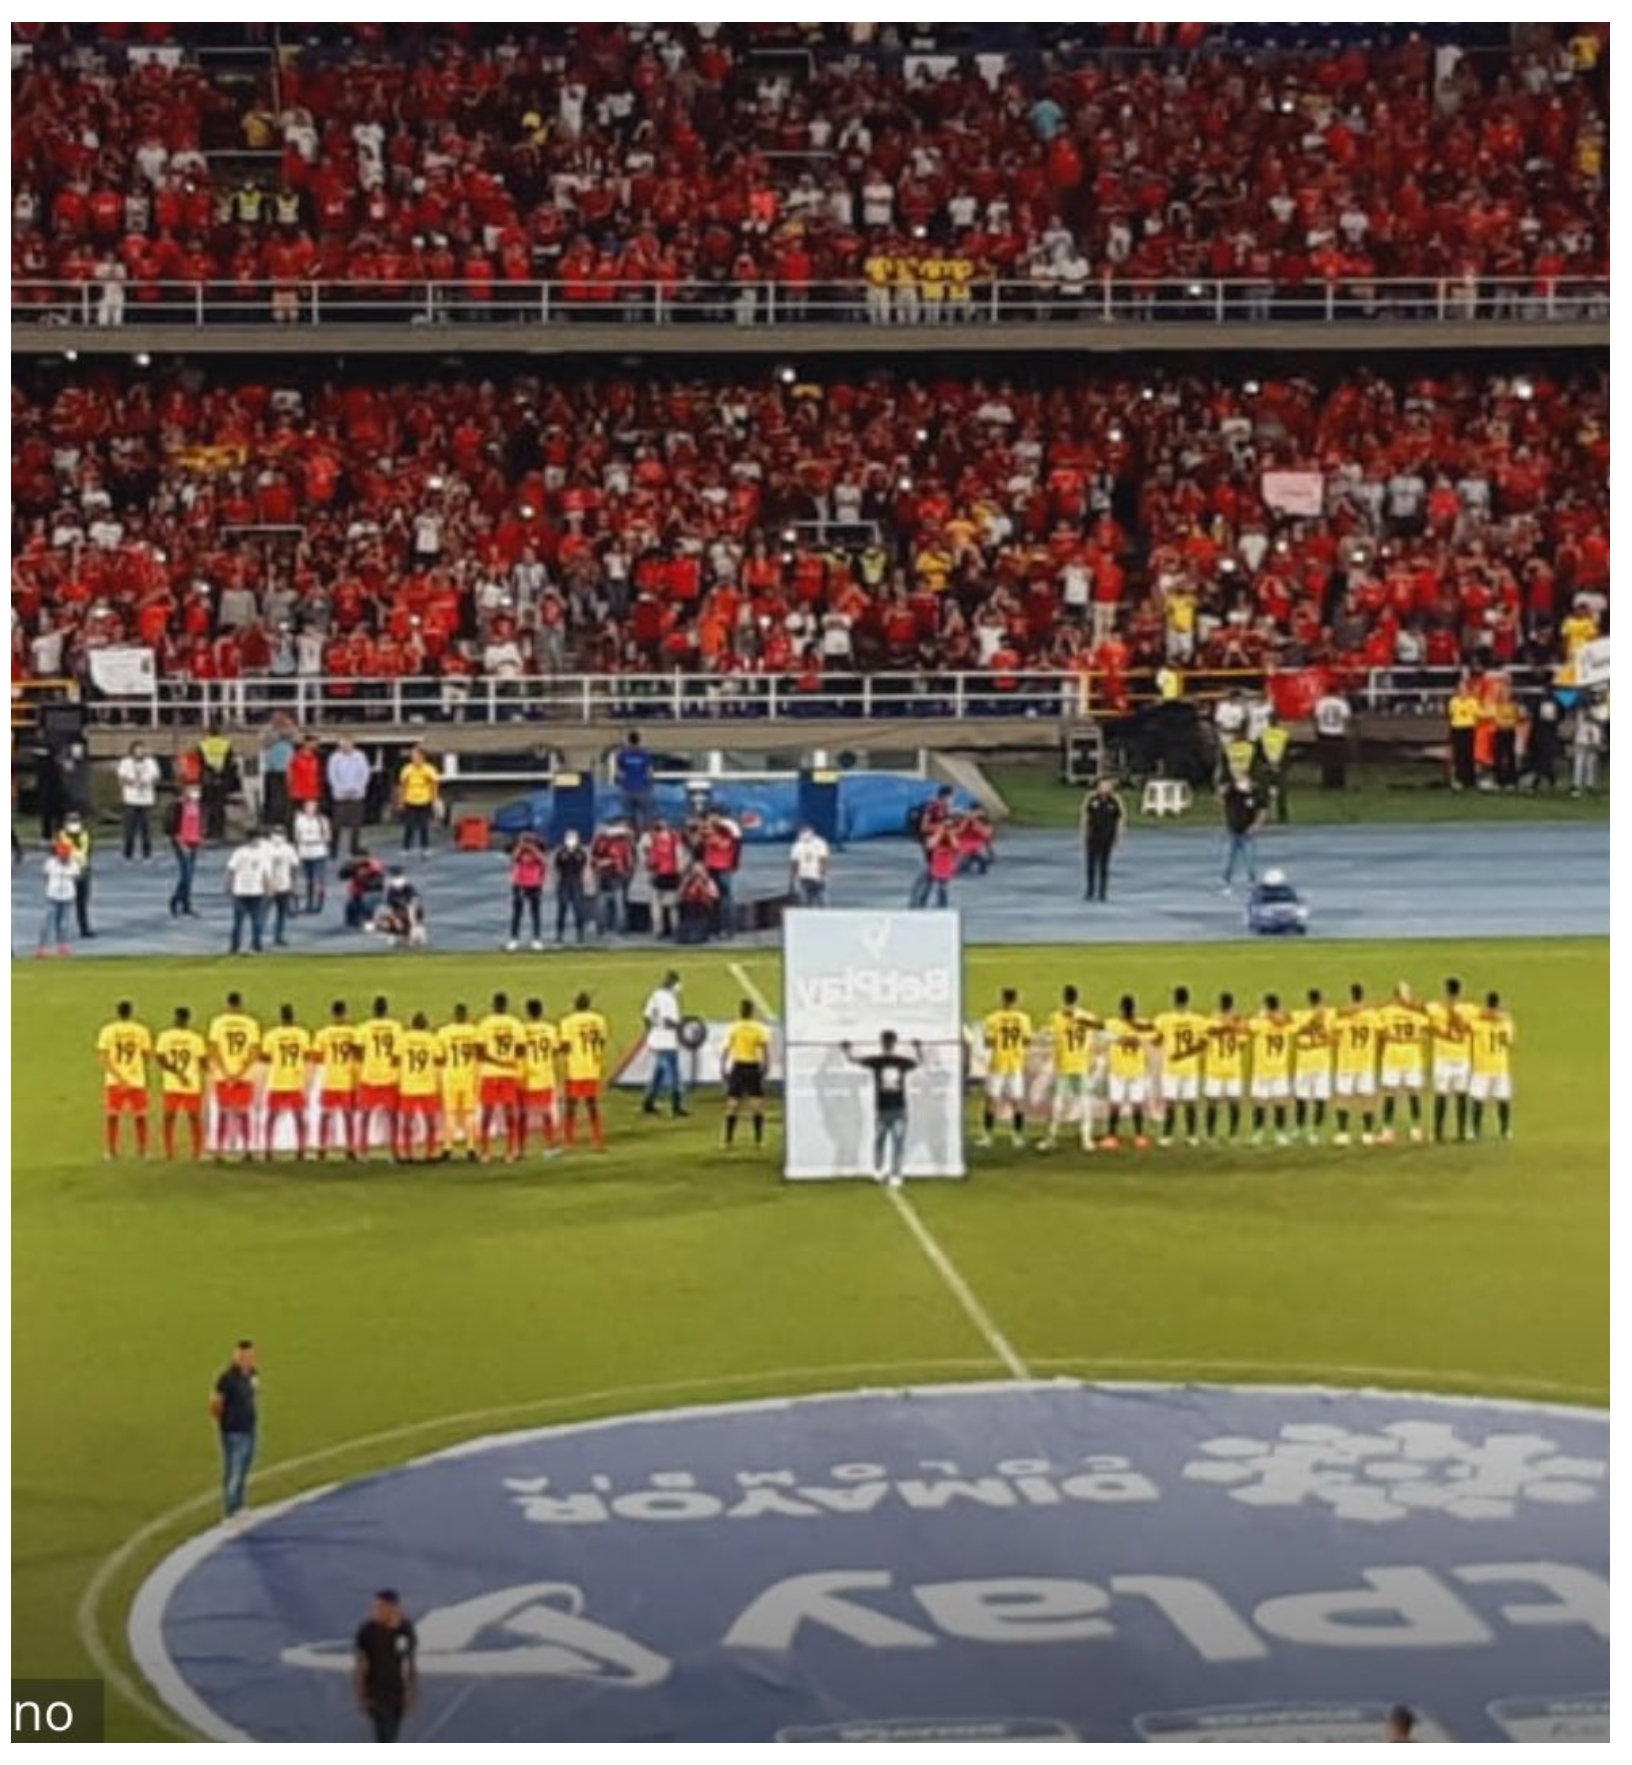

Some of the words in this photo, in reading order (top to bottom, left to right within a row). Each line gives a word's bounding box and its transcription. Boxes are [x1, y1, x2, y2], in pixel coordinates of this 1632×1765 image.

[227, 1031, 247, 1057] 19
[279, 1042, 299, 1067] 19
[373, 1033, 394, 1058] 19
[503, 1455, 1132, 1493] COLOMBIA
[513, 1472, 1161, 1523] DIMAYOR
